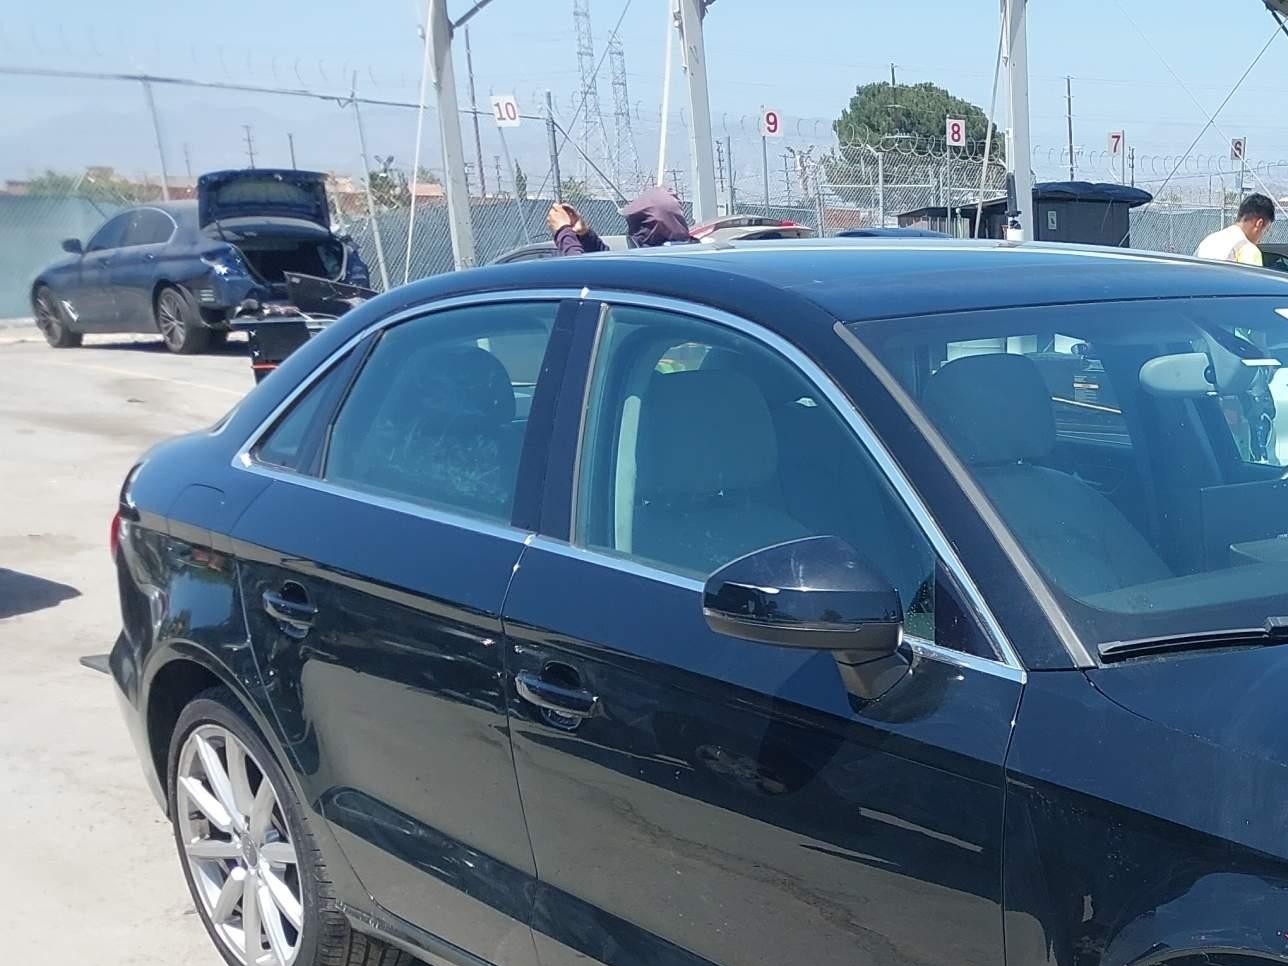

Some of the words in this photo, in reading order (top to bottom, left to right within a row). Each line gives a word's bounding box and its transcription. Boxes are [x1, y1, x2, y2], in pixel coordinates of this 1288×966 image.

[493, 101, 517, 121] 10
[765, 111, 778, 134] 9
[951, 122, 961, 143] 8
[1111, 134, 1121, 153] 7
